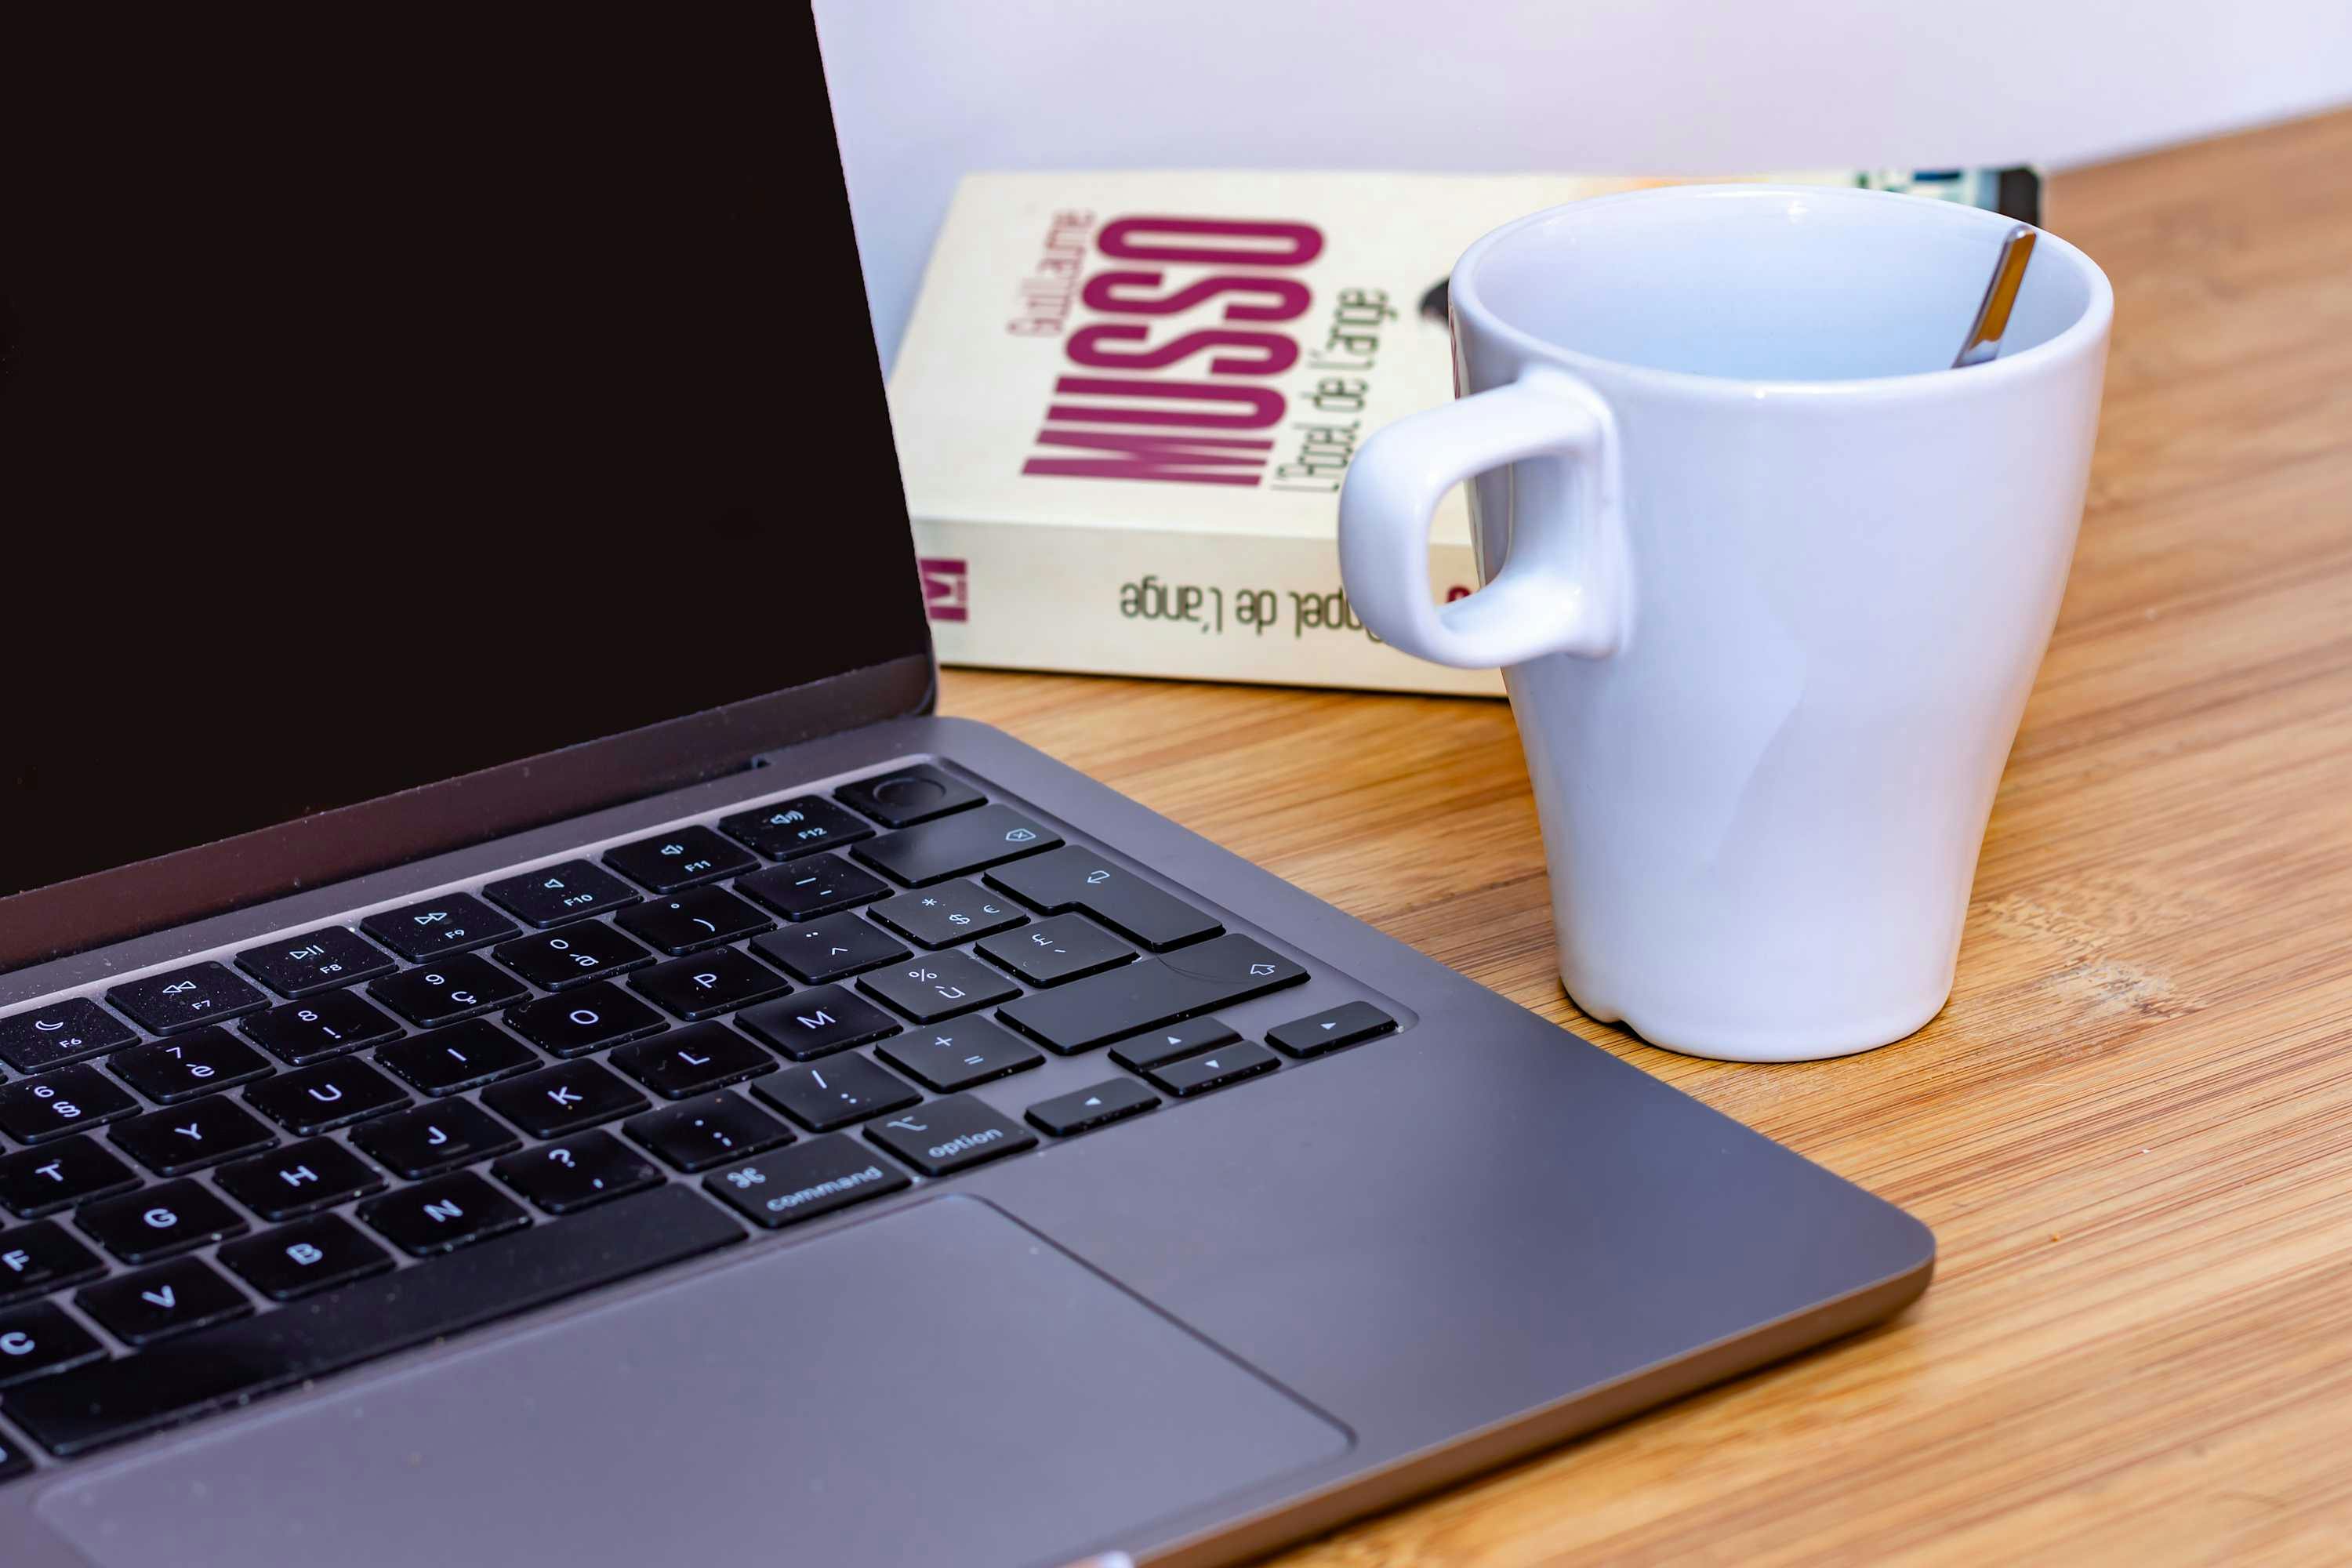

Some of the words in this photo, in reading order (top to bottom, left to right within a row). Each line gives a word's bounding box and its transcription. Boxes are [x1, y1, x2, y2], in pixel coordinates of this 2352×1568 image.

[1021, 215, 1325, 488] MUSSO
[1298, 377, 1369, 413] de
[1236, 589, 1277, 636] de
[797, 827, 827, 840] F12
[684, 860, 711, 873] F11
[564, 894, 593, 906] F10
[949, 913, 971, 925] $
[445, 929, 465, 939] F9
[550, 938, 569, 949] 0
[569, 953, 599, 967] à
[319, 964, 343, 975] F8
[908, 968, 938, 982] %
[425, 974, 445, 985] 9
[693, 973, 717, 989] P
[451, 991, 477, 1004] ç
[935, 985, 966, 999] ù
[191, 1000, 211, 1011] F7
[297, 1010, 318, 1022] 8
[569, 1009, 599, 1025] O
[796, 1010, 837, 1029] M
[59, 1037, 82, 1048] F6
[165, 1047, 182, 1059] 7
[677, 1051, 710, 1065] L
[186, 1063, 215, 1078] è
[34, 1085, 55, 1098] 6
[308, 1083, 343, 1102] U
[547, 1086, 583, 1105] K
[174, 1123, 202, 1140] Y
[428, 1126, 448, 1145] J
[928, 1127, 1004, 1158] option
[548, 1149, 575, 1167] ?
[34, 1163, 64, 1181] T
[280, 1165, 318, 1187] H
[766, 1164, 884, 1212] command
[143, 1208, 178, 1228] G
[423, 1199, 463, 1222] N
[2, 1250, 29, 1272] F
[286, 1243, 323, 1265] B
[142, 1285, 176, 1308] V
[0, 1331, 35, 1356] C
